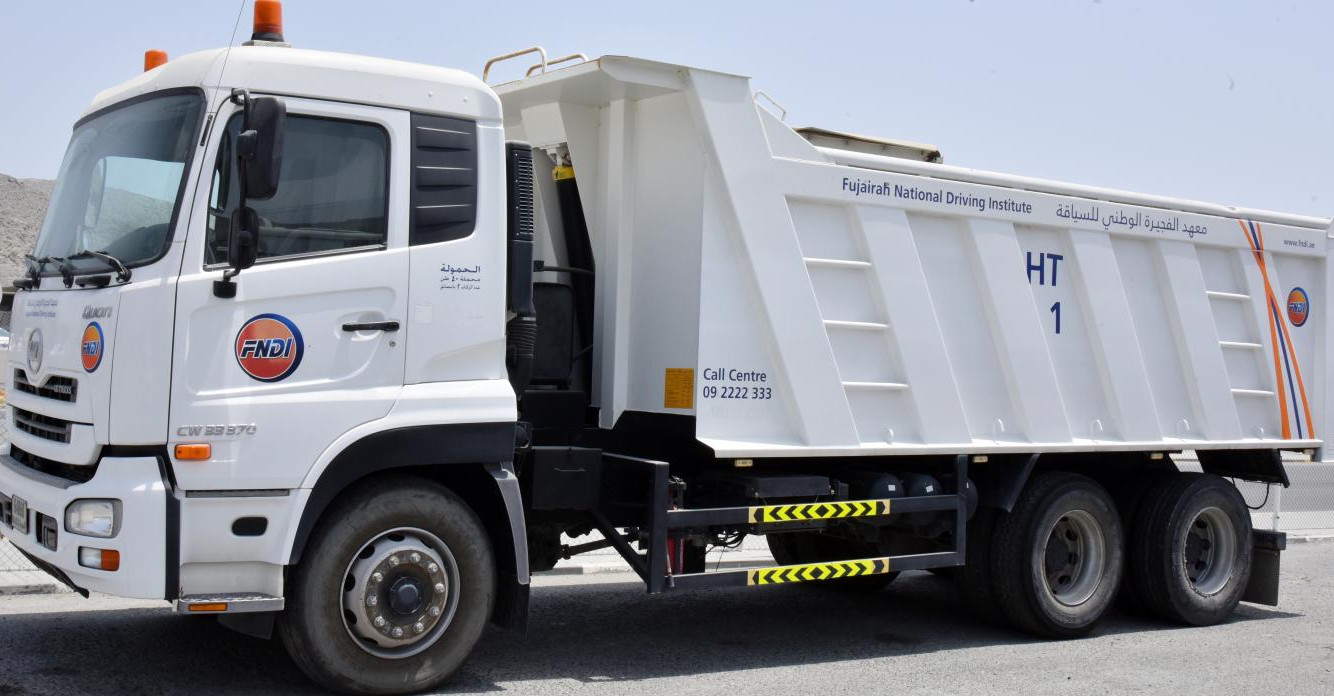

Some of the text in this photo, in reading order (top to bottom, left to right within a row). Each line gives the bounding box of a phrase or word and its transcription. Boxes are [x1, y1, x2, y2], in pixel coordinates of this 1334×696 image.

[842, 178, 1032, 214] Fujairah National Driving Institute
[1056, 204, 1208, 238] معهد الفجيرة الوطني للسياقة
[1027, 252, 1064, 286] HT
[1050, 302, 1060, 334] 1
[240, 338, 294, 358] FNDI
[704, 368, 766, 382] Call Centre
[703, 386, 772, 400] 09 2222 333
[176, 426, 203, 436] CW
